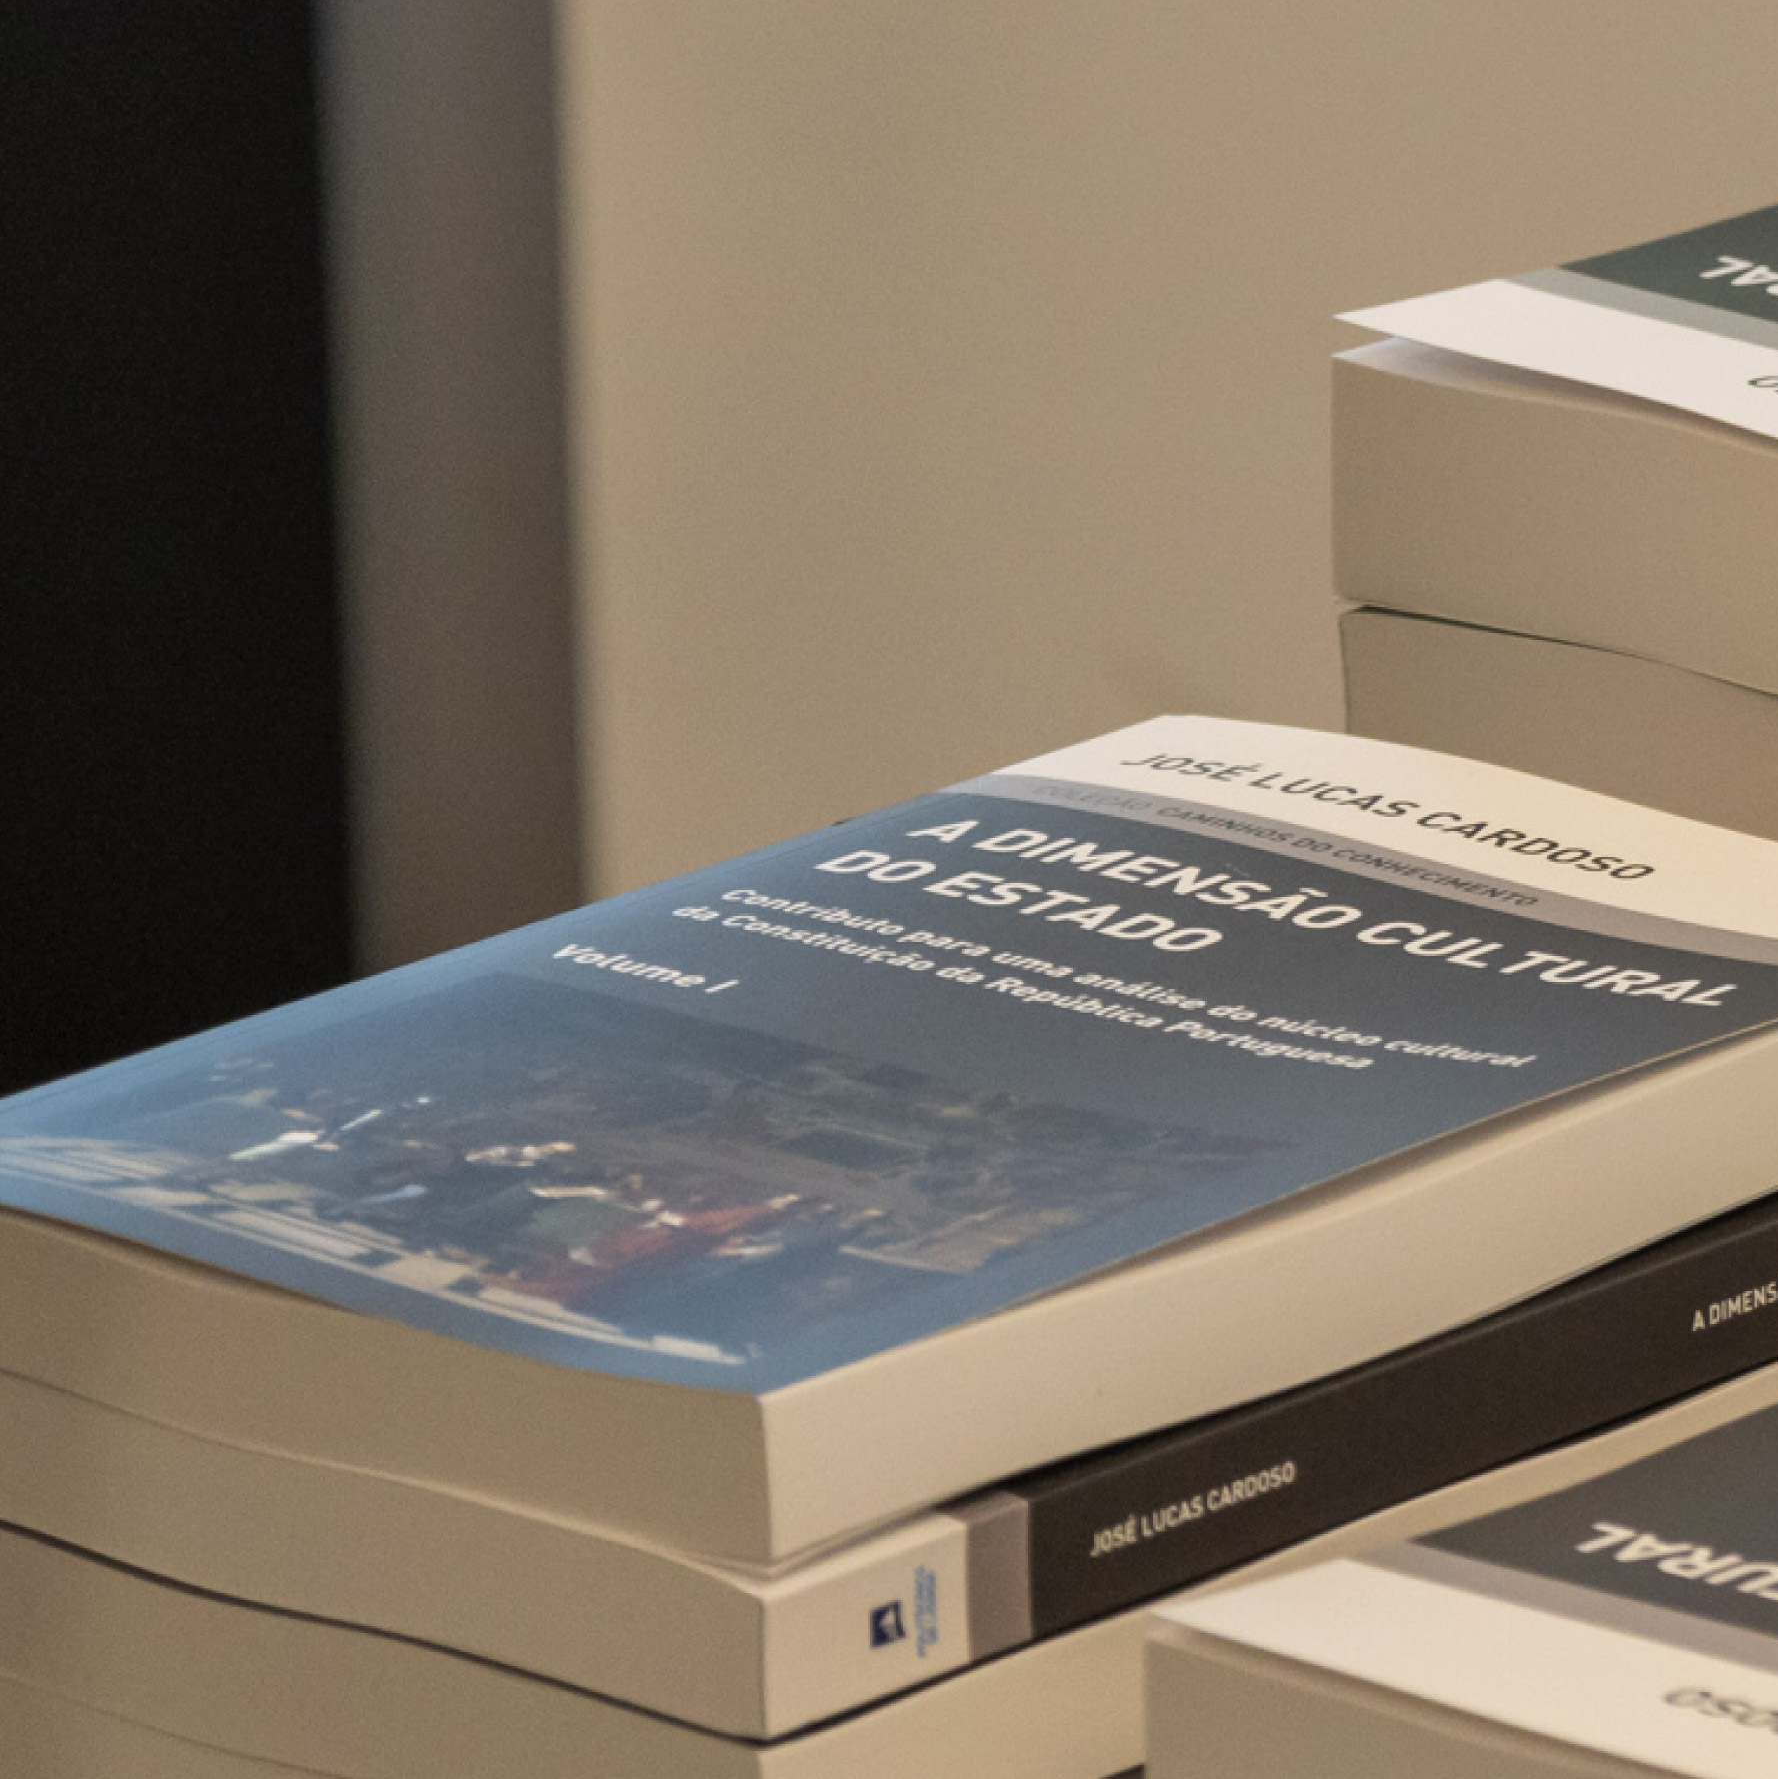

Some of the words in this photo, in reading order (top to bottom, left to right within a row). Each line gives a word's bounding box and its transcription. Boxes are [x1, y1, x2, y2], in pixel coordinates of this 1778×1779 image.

[1119, 753, 1262, 781] JOSÉ
[1248, 771, 1420, 818] LUCAS
[1416, 810, 1655, 882] CARDOSO
[1155, 806, 1291, 844] CAMINHOS
[1293, 836, 1333, 853] DO
[1332, 848, 1541, 908] CONHECIMENTO
[813, 850, 936, 882] DO
[922, 870, 1223, 952] ESTADO
[906, 819, 979, 844] A
[973, 827, 1362, 929] DIMENSÃO
[1357, 921, 1737, 1007] CULTURAL
[551, 943, 706, 989] Volume
[671, 905, 720, 922] da
[720, 915, 936, 973] Constituição
[935, 966, 986, 985] da
[984, 976, 1164, 1029] República
[1162, 1020, 1374, 1071] Portuguesa
[720, 889, 904, 937] Contributo
[897, 929, 991, 958] para
[992, 949, 1074, 979] uma
[1074, 969, 1206, 1011] análise
[1208, 1004, 1257, 1022] do
[1256, 1015, 1383, 1048] núcleo
[1383, 1039, 1538, 1069] cultural
[1692, 1309, 1706, 1332] A
[1090, 1514, 1138, 1557] JOSÉ
[1142, 1495, 1204, 1538] LUCAS
[1206, 1461, 1297, 1511] CARDOSO
